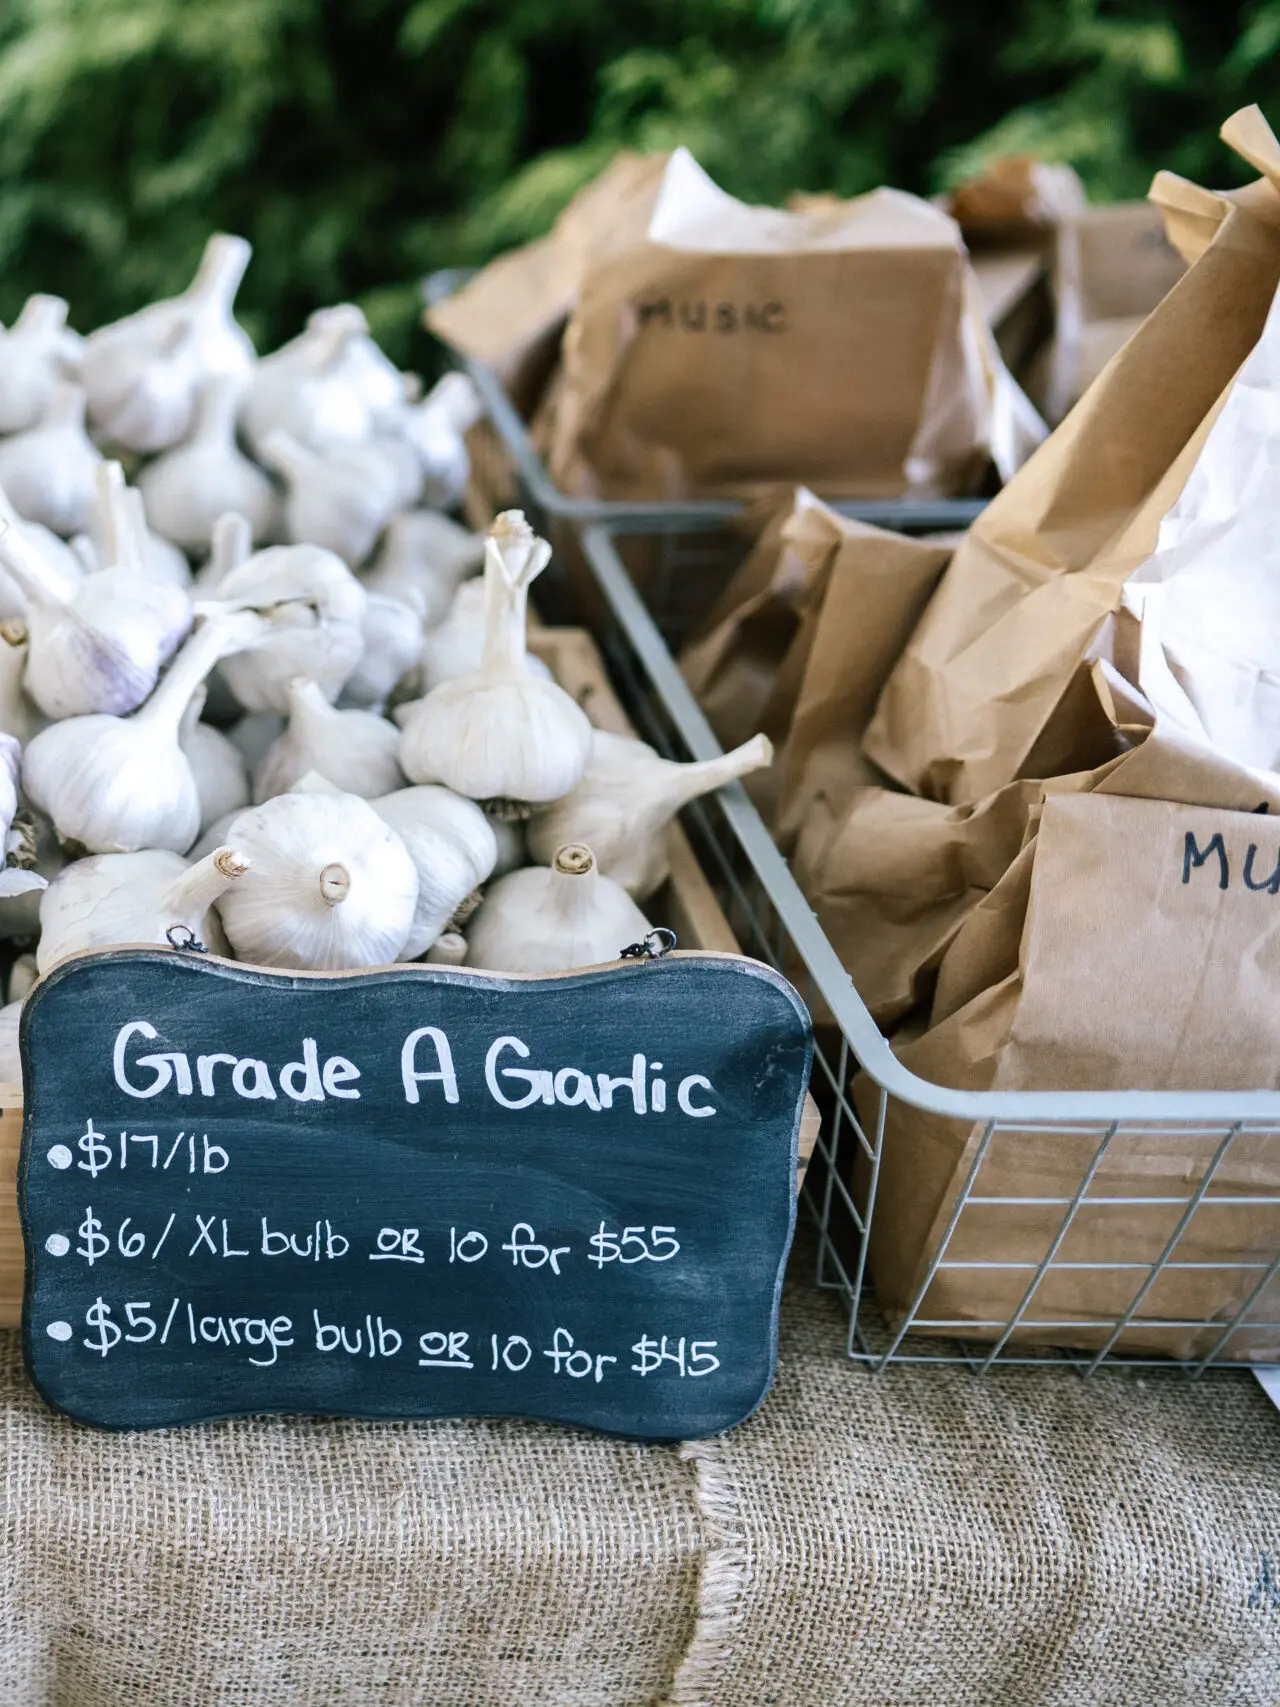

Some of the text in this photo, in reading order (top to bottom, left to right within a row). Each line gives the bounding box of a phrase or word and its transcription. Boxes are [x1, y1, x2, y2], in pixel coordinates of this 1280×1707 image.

[637, 298, 787, 334] MUSIC
[112, 1020, 718, 1118] Grade A Garlic
[77, 1118, 230, 1178] $17/lb
[76, 1206, 681, 1276] $6/ XL bulb OR 10 for $55
[313, 1308, 403, 1359] bulb
[417, 1330, 474, 1370] OR
[490, 1333, 532, 1372] 10
[543, 1327, 618, 1384] for
[630, 1332, 721, 1377] $45
